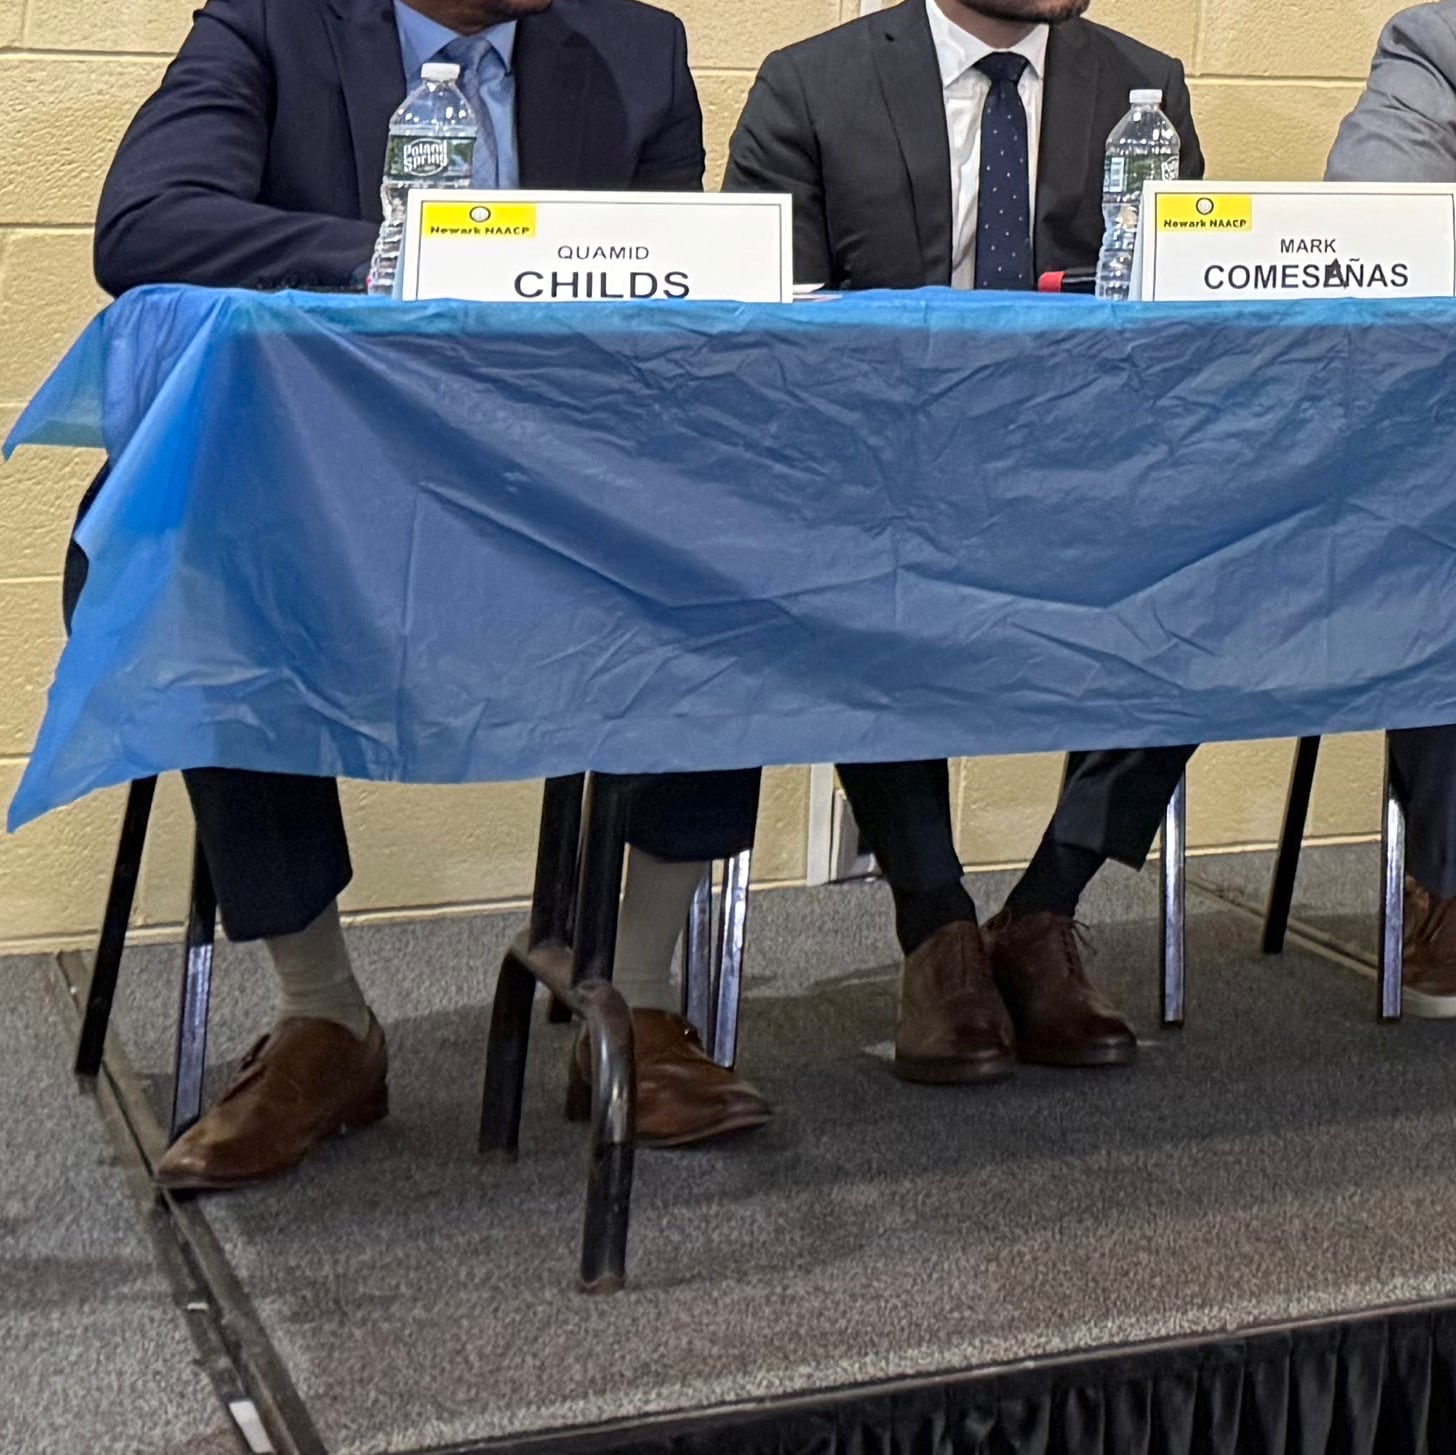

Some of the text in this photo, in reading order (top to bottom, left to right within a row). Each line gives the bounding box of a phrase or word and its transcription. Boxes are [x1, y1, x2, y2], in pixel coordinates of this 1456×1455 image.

[403, 140, 448, 156] Poland
[403, 154, 448, 172] Spring
[430, 226, 530, 235] Newark NAACP
[1163, 219, 1247, 228] Newark NAACP
[557, 245, 650, 260] QUAMID
[1280, 238, 1337, 254] MARK
[514, 271, 690, 299] CHILDS
